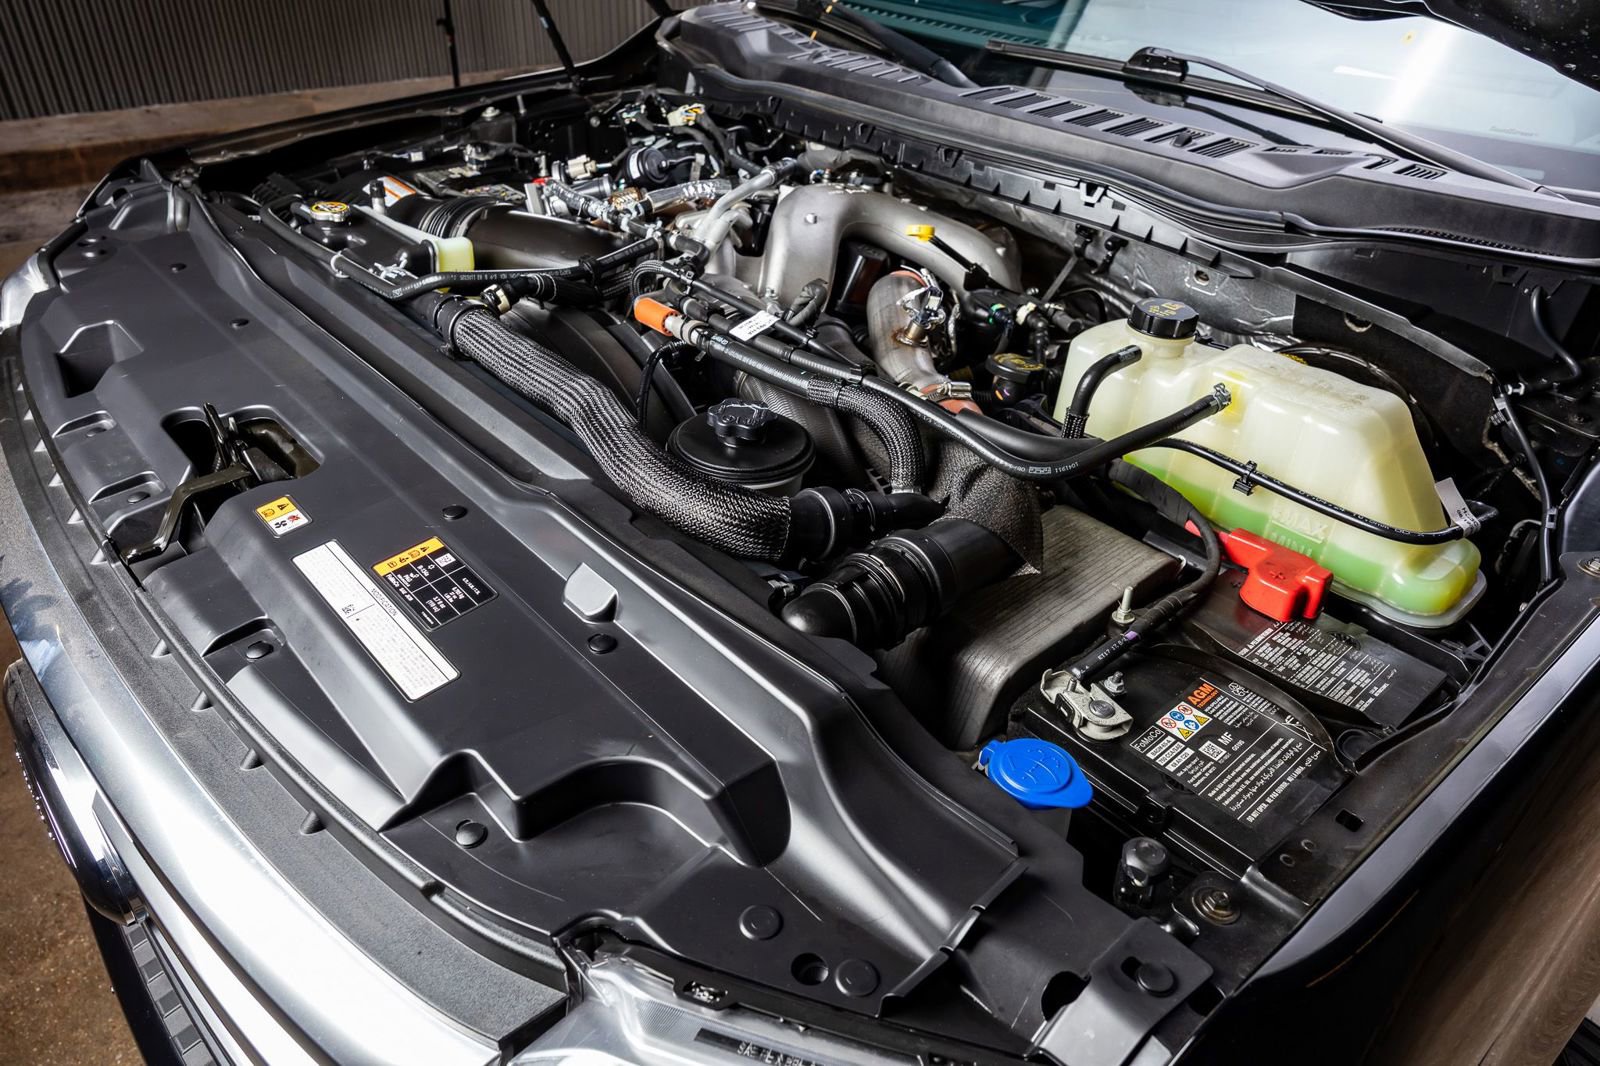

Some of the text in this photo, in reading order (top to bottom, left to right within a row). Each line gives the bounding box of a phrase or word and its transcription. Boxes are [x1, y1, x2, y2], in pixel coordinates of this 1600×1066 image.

[371, 588, 397, 616] MODIFICATION
[1188, 684, 1214, 705] AGM
[1134, 730, 1161, 750] FoMoCo
[1218, 732, 1233, 746] MF
